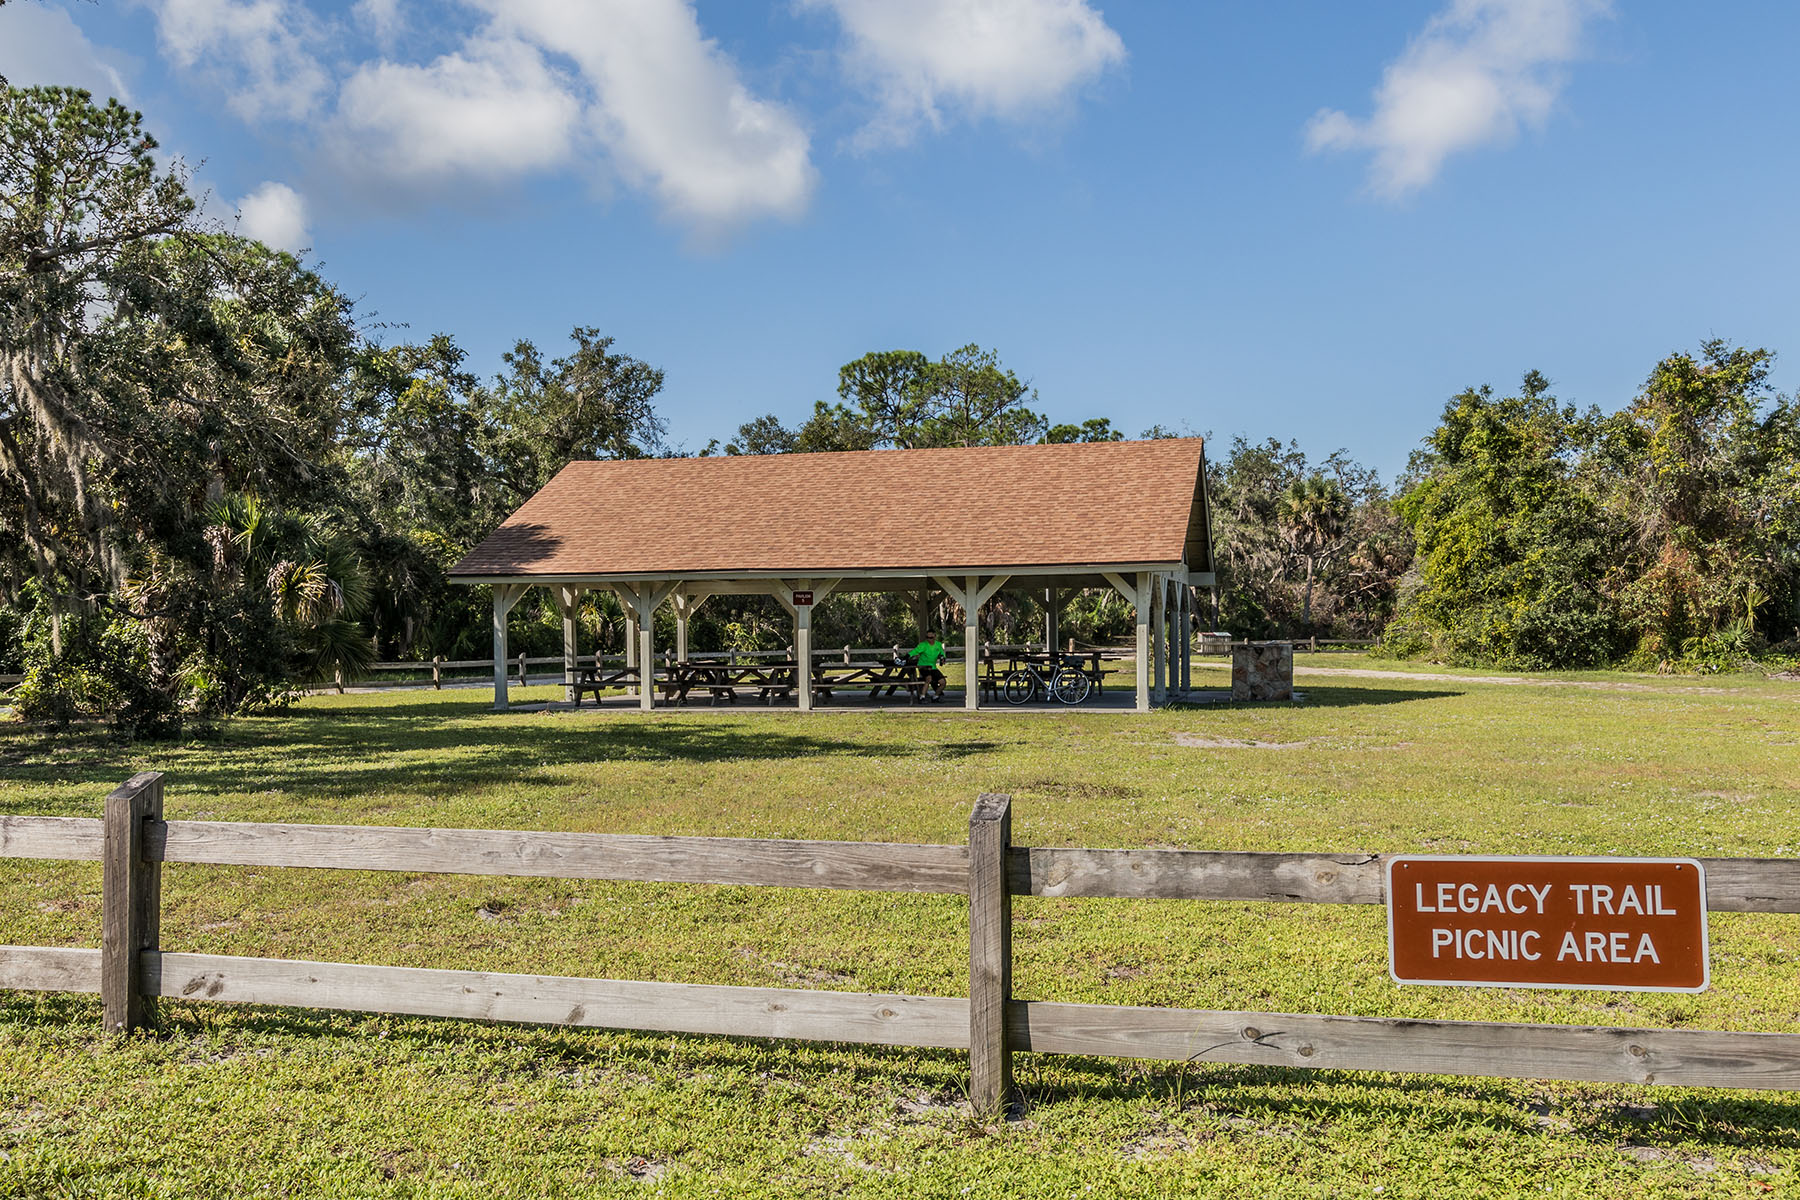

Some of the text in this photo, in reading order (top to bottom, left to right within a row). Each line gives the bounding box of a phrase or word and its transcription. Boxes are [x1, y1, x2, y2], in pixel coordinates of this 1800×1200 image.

[1416, 883, 1676, 915] LEGACY TRAIL
[1433, 929, 1660, 963] PICNIC AREA
